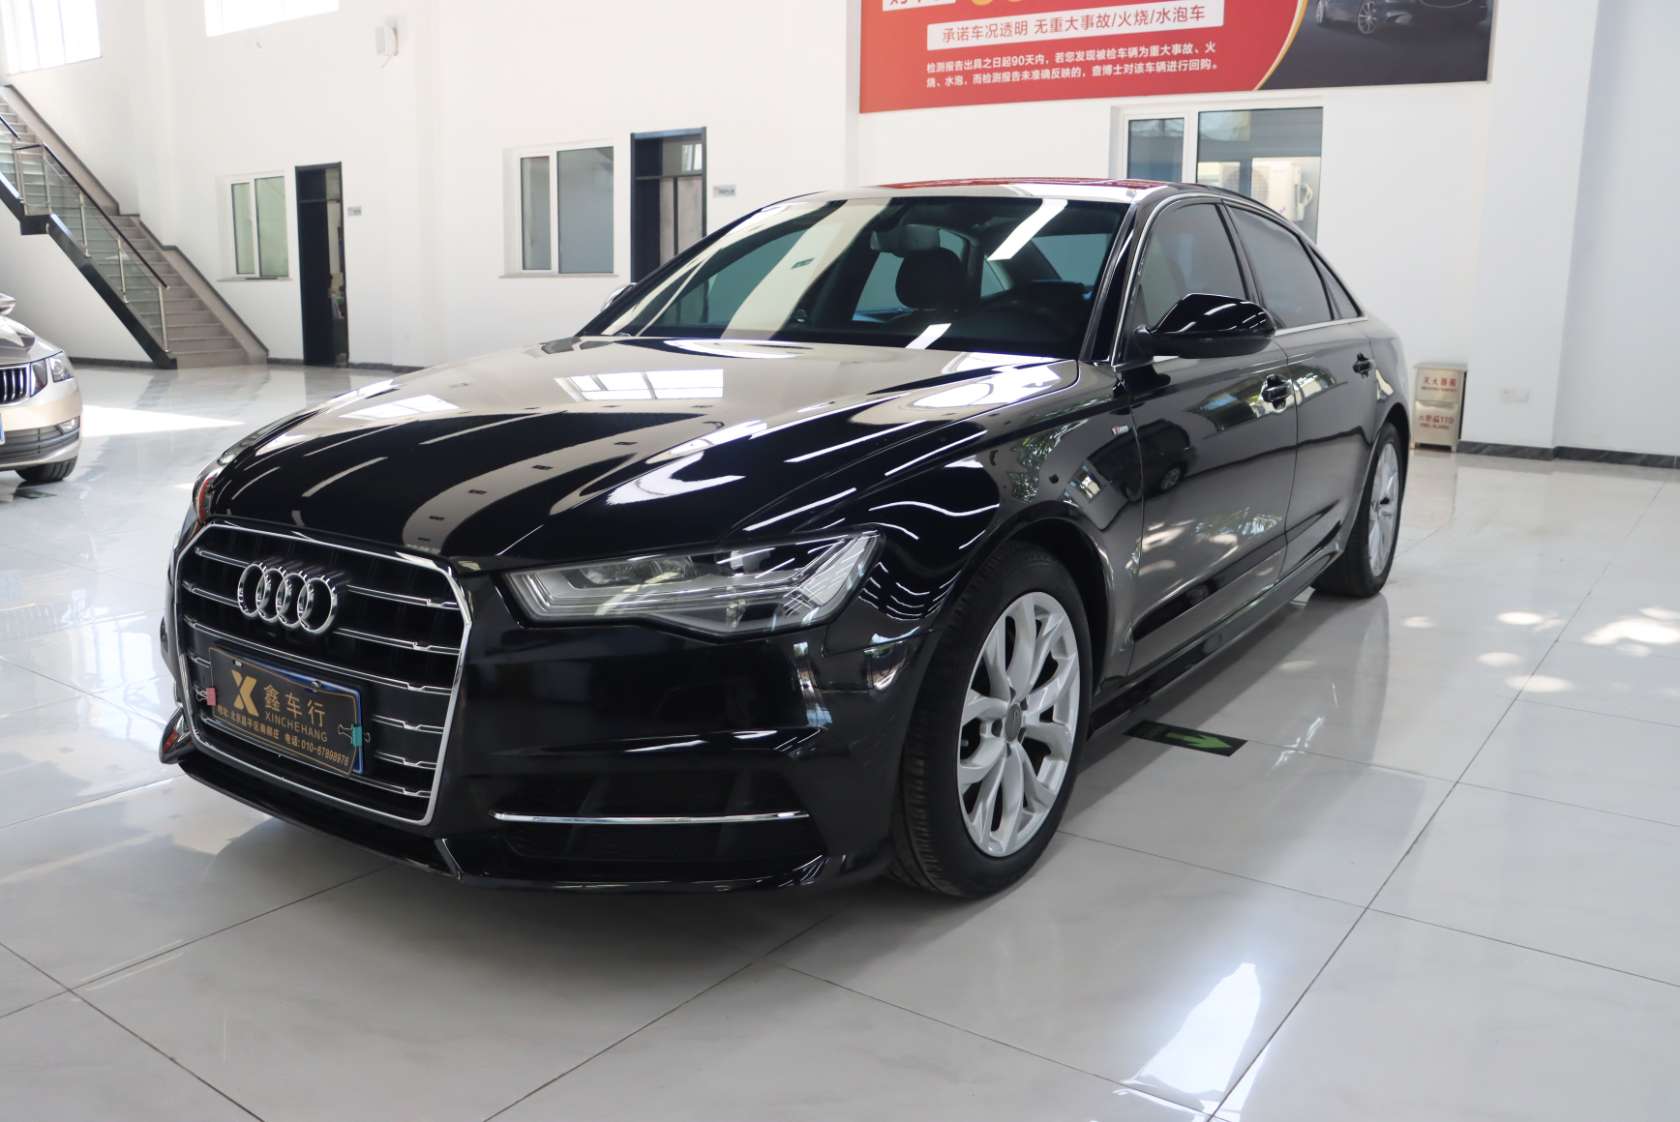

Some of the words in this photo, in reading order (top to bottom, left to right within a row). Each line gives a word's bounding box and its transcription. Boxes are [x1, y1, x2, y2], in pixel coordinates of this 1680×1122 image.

[942, 20, 1028, 44] 承诺车况透明
[1034, 5, 1206, 34] 无重大事故/火烧/水泡车
[264, 684, 326, 727] 鑫车行
[265, 711, 328, 742] XINCHEHANG
